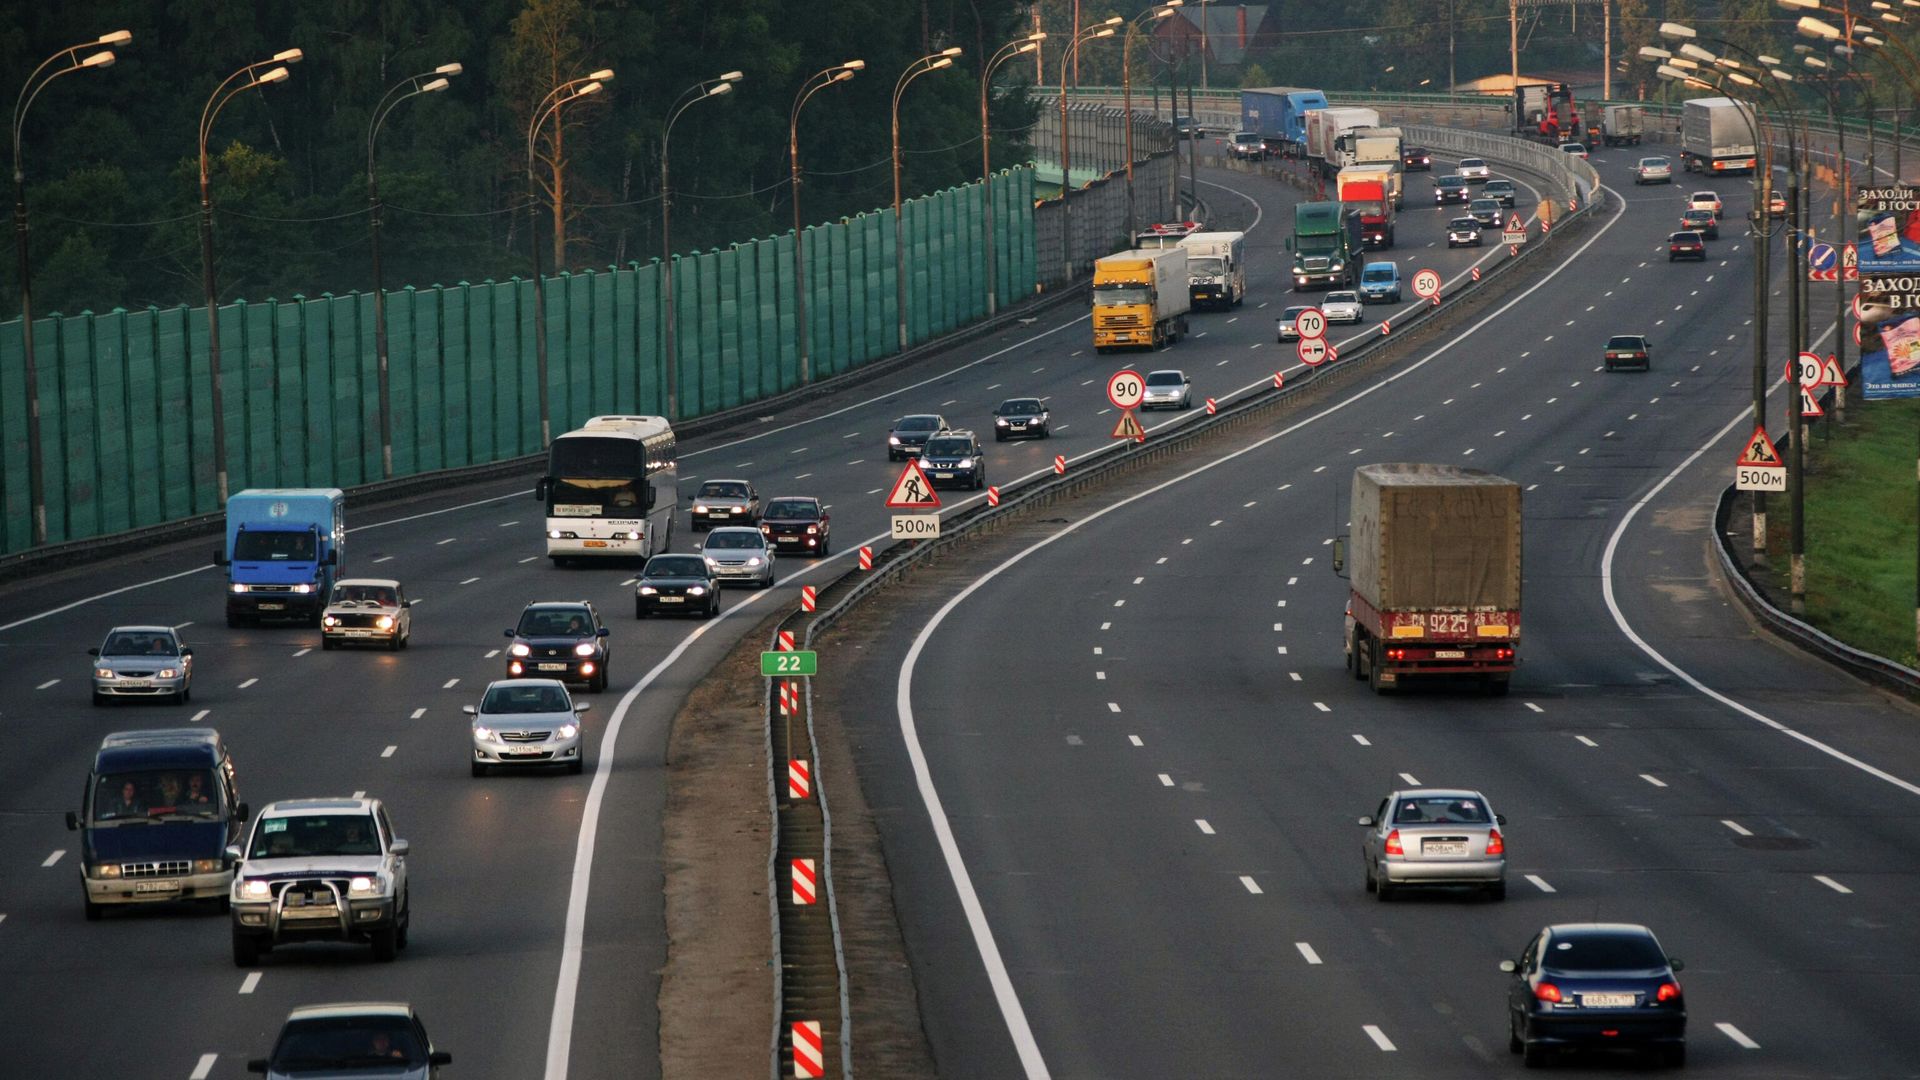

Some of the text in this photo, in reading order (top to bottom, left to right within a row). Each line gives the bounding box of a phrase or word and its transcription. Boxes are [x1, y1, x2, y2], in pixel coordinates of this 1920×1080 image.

[1860, 189, 1913, 200] ЗАХОДИ
[1879, 201, 1886, 211] В
[1419, 279, 1434, 290] 50
[1890, 295, 1901, 308] В
[1303, 318, 1320, 330] 70
[1116, 382, 1137, 397] 90
[1740, 471, 1782, 485] 500м
[895, 520, 936, 533] 500м
[777, 656, 801, 671] 22
